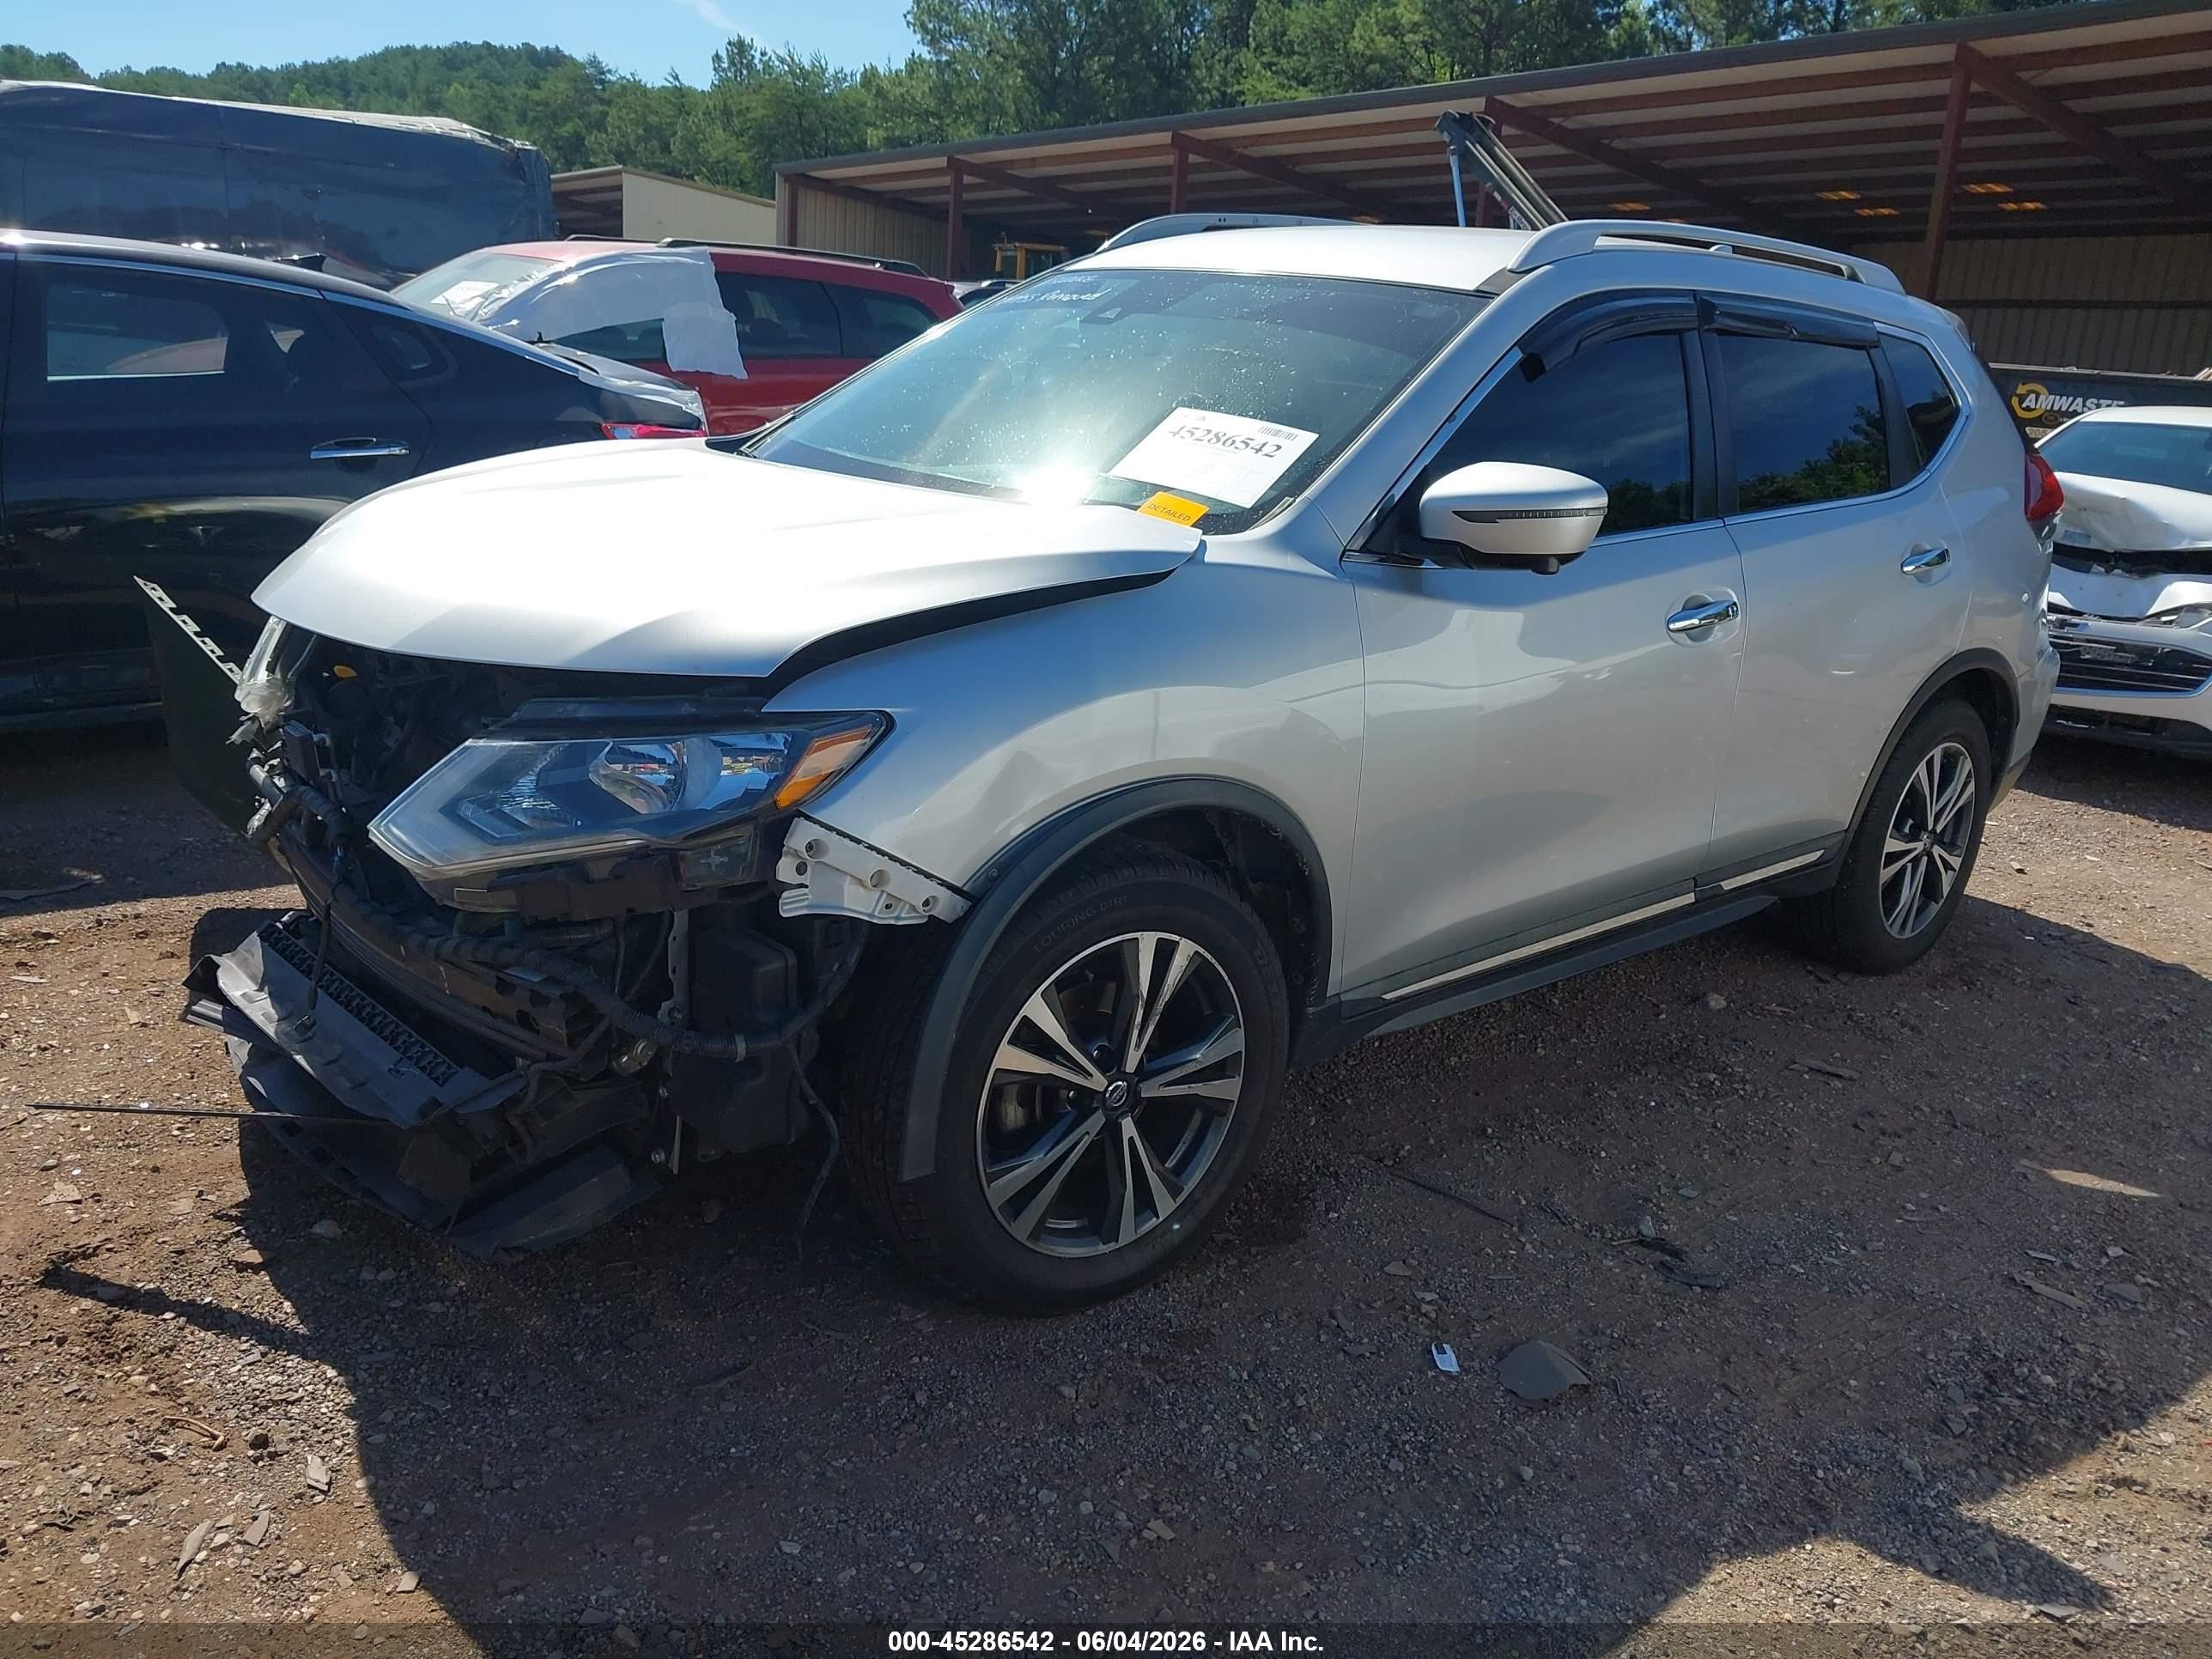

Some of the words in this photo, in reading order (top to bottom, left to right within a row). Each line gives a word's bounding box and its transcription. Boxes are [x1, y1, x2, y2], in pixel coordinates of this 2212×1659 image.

[1168, 425, 1284, 459] 45286542
[1146, 503, 1192, 523] DETAILED
[1030, 906, 1097, 954] TOURING
